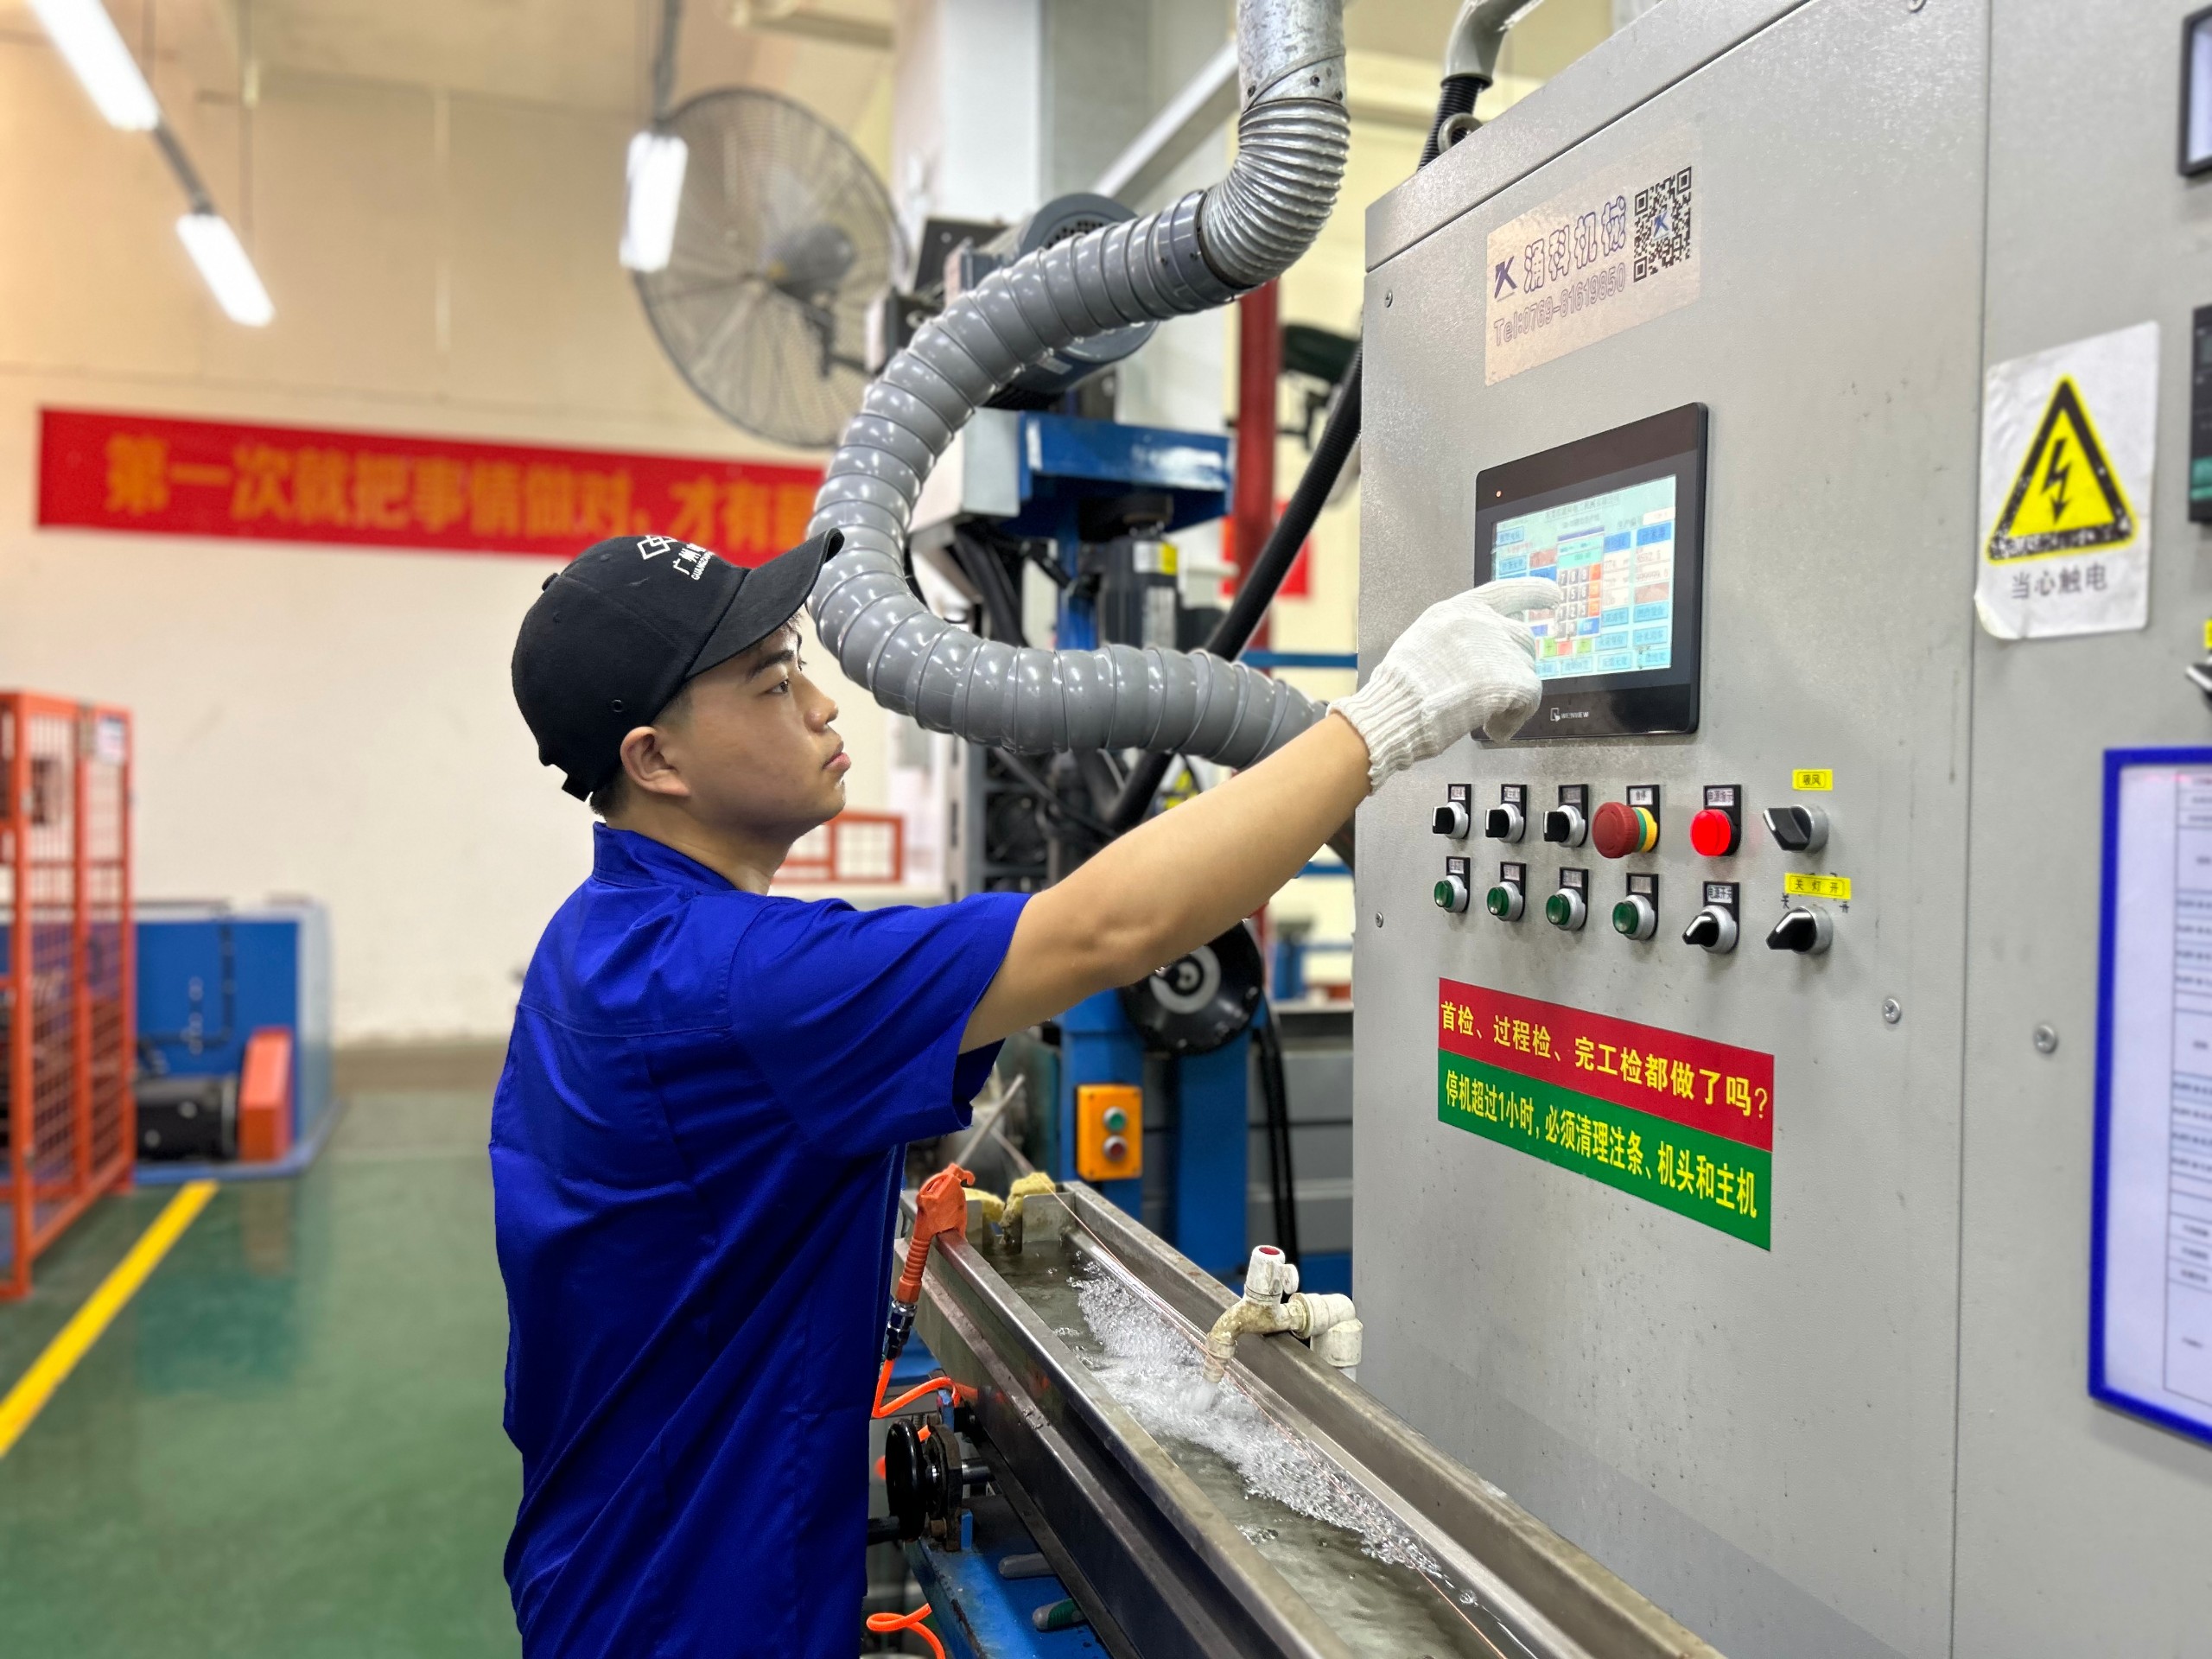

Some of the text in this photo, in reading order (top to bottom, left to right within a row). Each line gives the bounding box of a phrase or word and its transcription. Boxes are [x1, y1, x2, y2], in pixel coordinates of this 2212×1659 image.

[1493, 262, 1626, 346] Tel:0769-81619850
[2012, 563, 2107, 601] 当心触电
[1440, 1001, 1769, 1120] 首检、过程检、完工检都做了吗?
[1446, 1070, 1758, 1218] 停机超过1小时,必须清理注条、机头和主机
